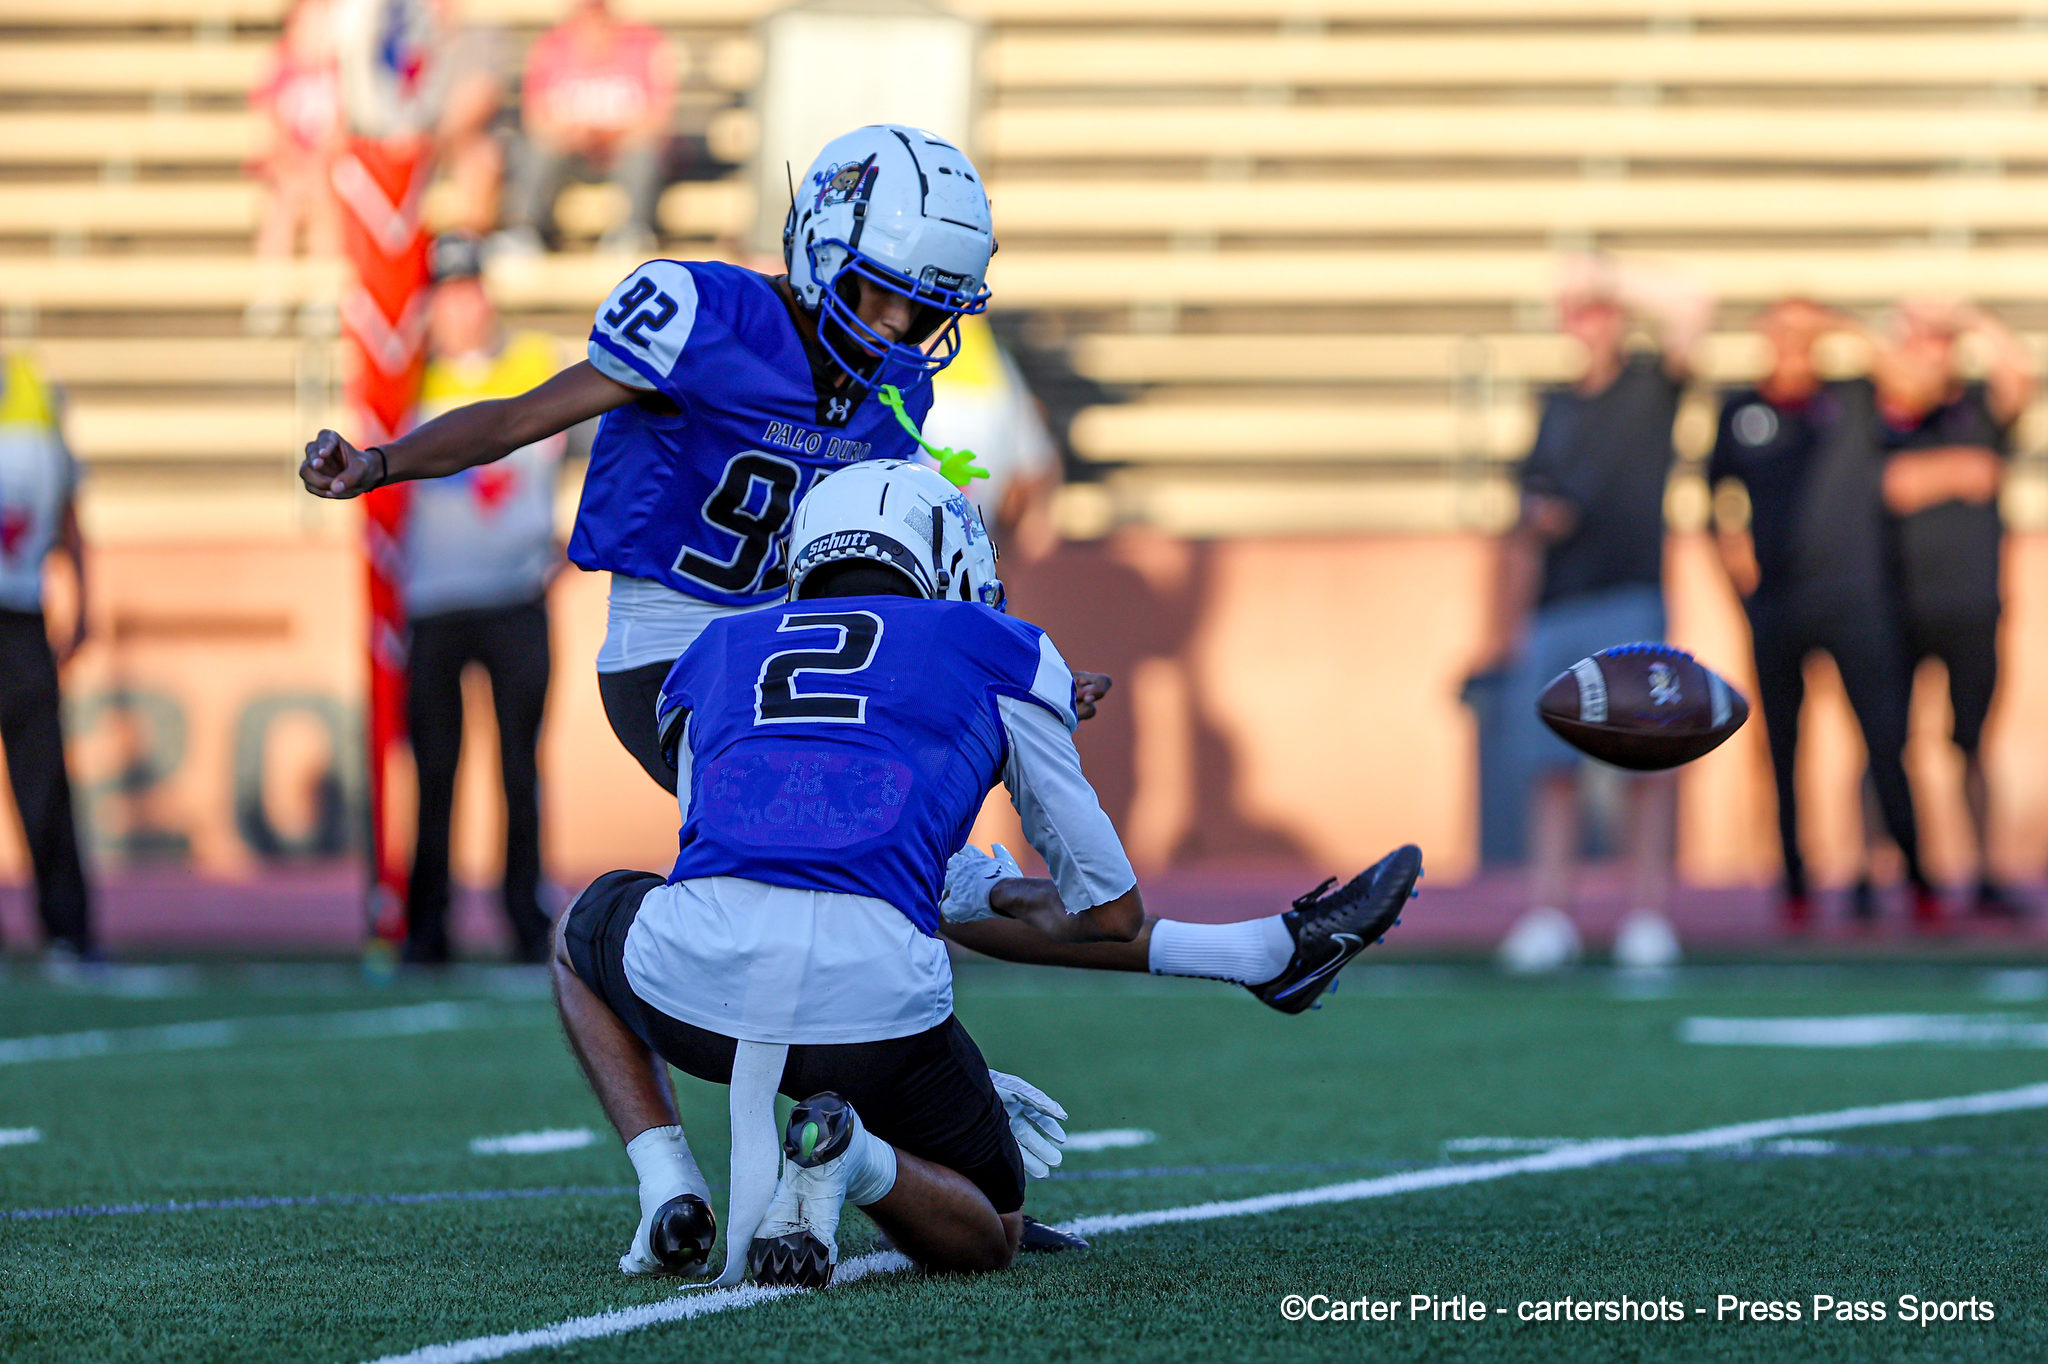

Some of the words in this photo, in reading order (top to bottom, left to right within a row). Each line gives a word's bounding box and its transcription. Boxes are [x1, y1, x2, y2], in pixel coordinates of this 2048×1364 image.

[604, 276, 679, 349] 92
[762, 420, 823, 455] PALO
[824, 436, 872, 462] DURO
[671, 450, 836, 594] 9
[808, 531, 871, 558] schutt
[753, 610, 885, 727] 2
[62, 684, 372, 862] 20
